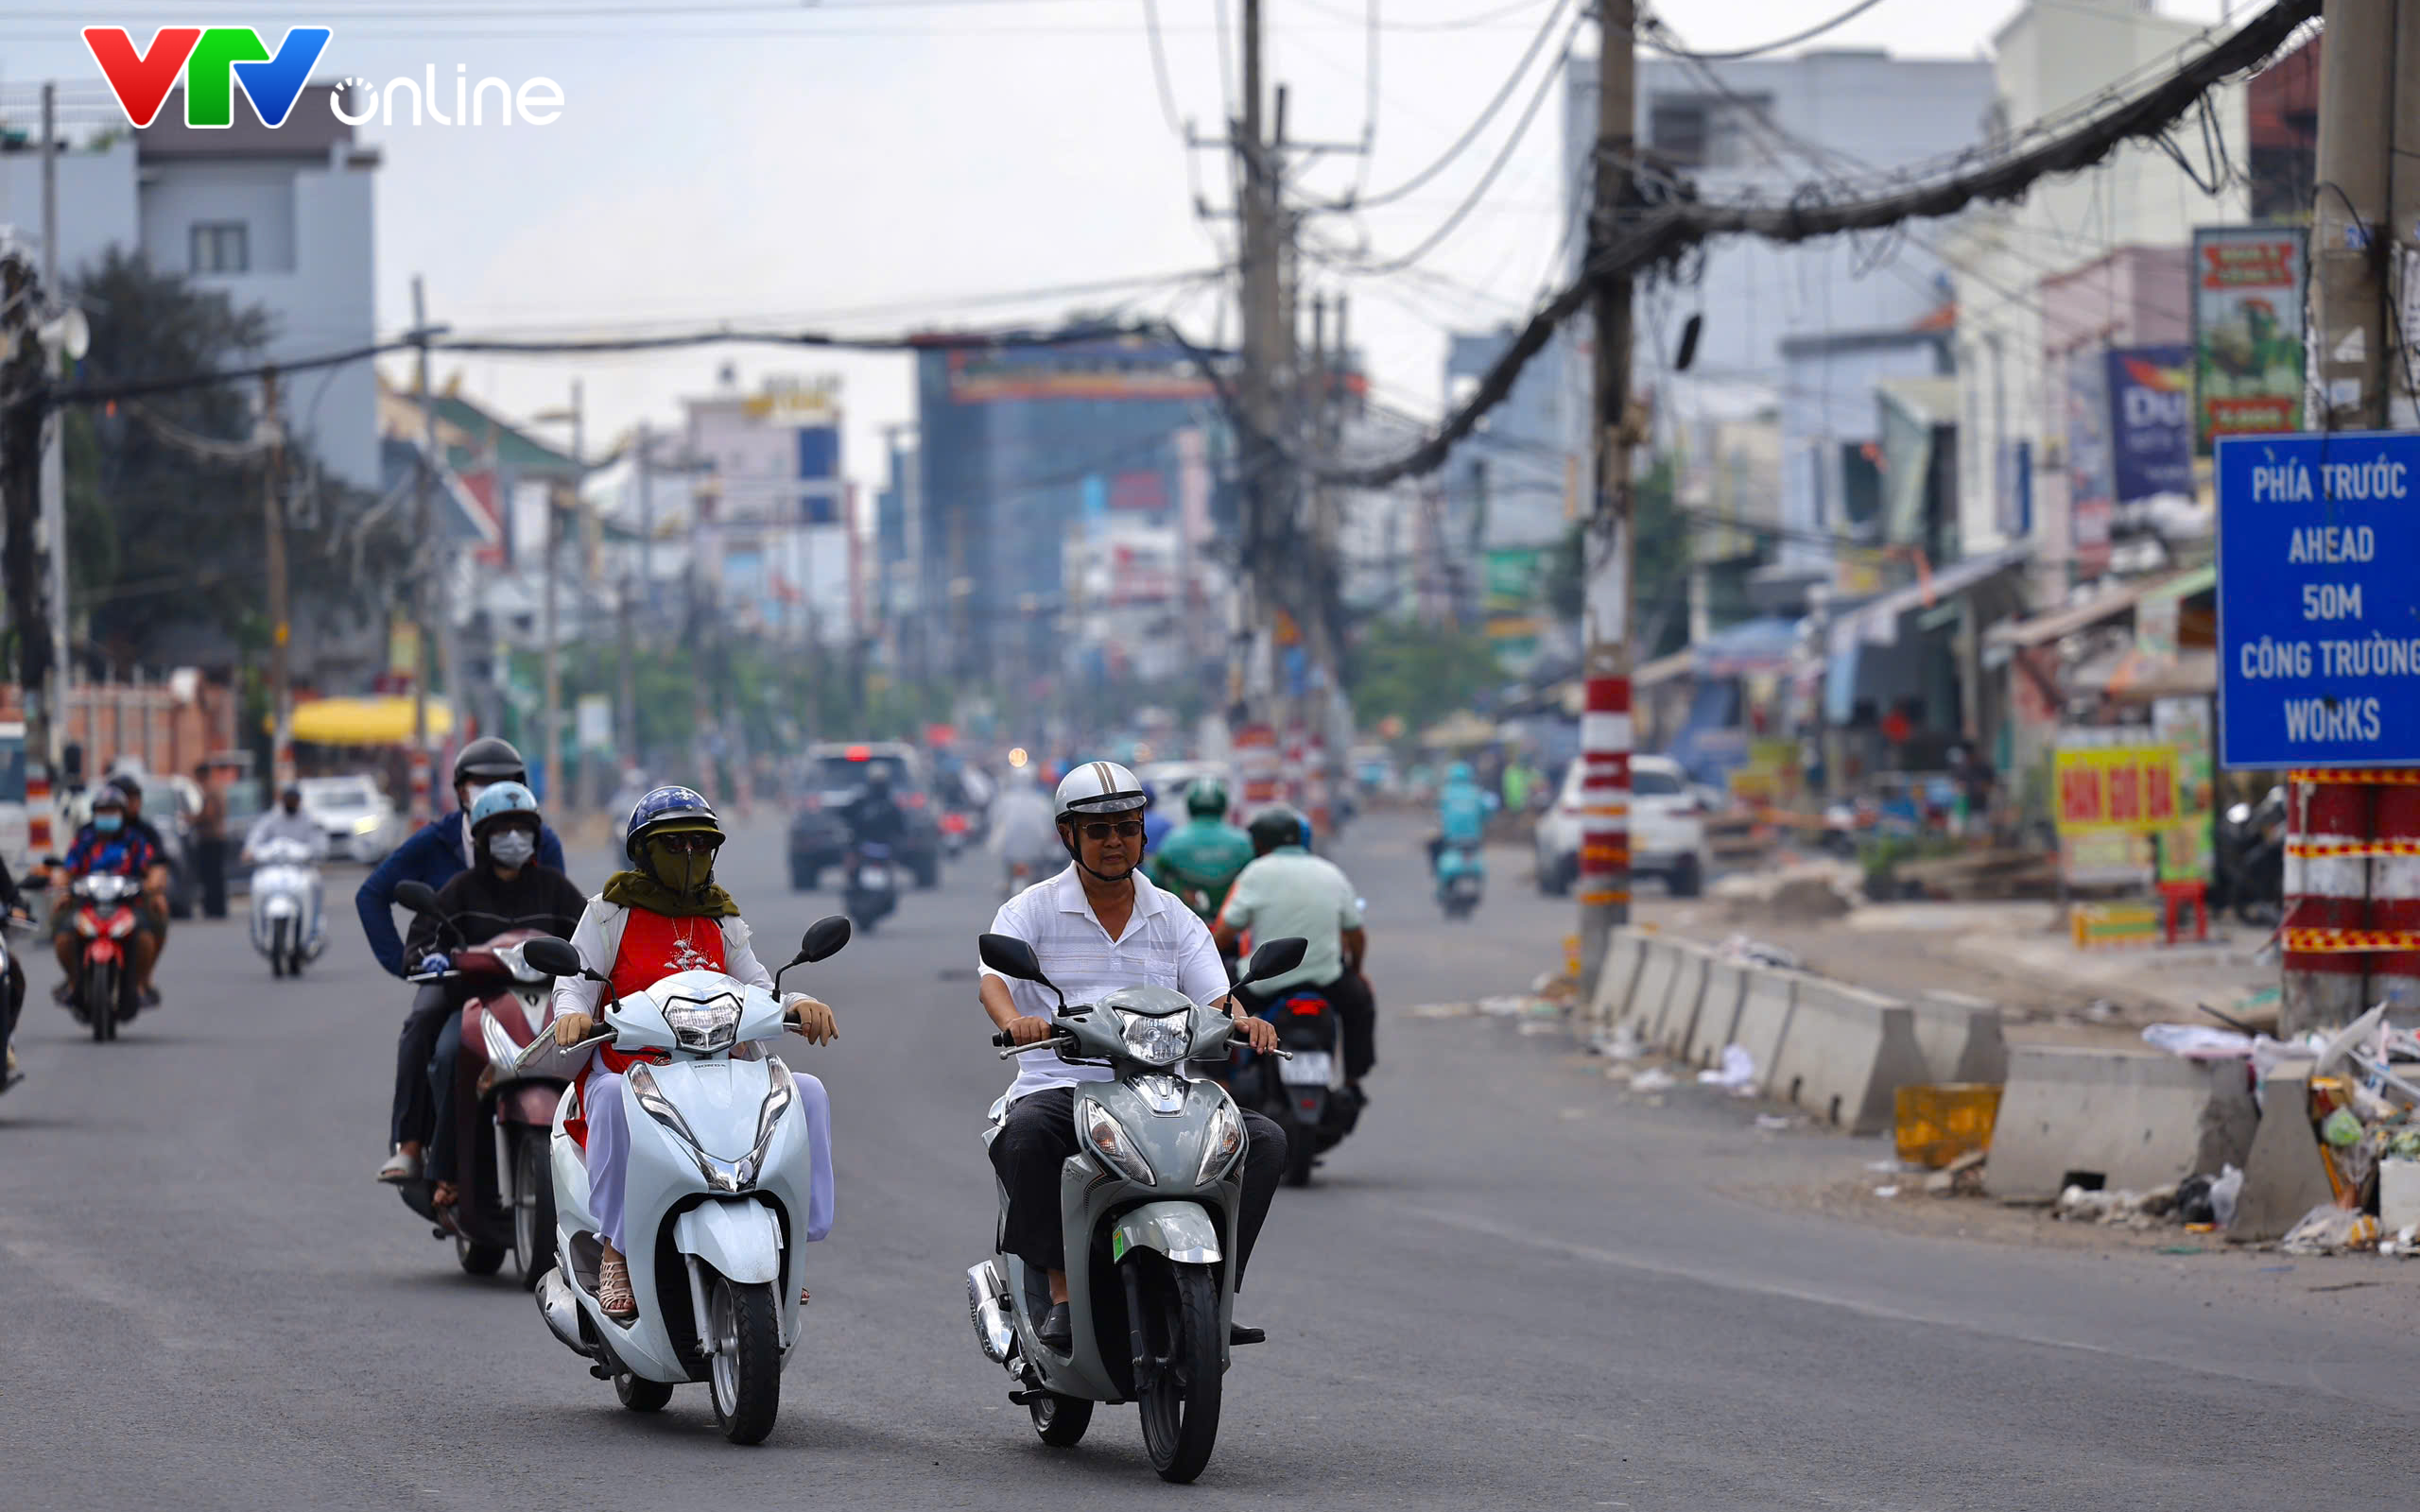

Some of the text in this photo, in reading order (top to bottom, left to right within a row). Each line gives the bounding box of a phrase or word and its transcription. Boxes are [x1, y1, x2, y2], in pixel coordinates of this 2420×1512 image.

[2252, 452, 2408, 503] PHÍA TRƯỚC
[2289, 524, 2375, 563] AHEAD
[2303, 582, 2362, 621] 50M
[2239, 628, 2420, 679] CÔNG TRƯỜNG
[2284, 696, 2380, 743] WORKS
